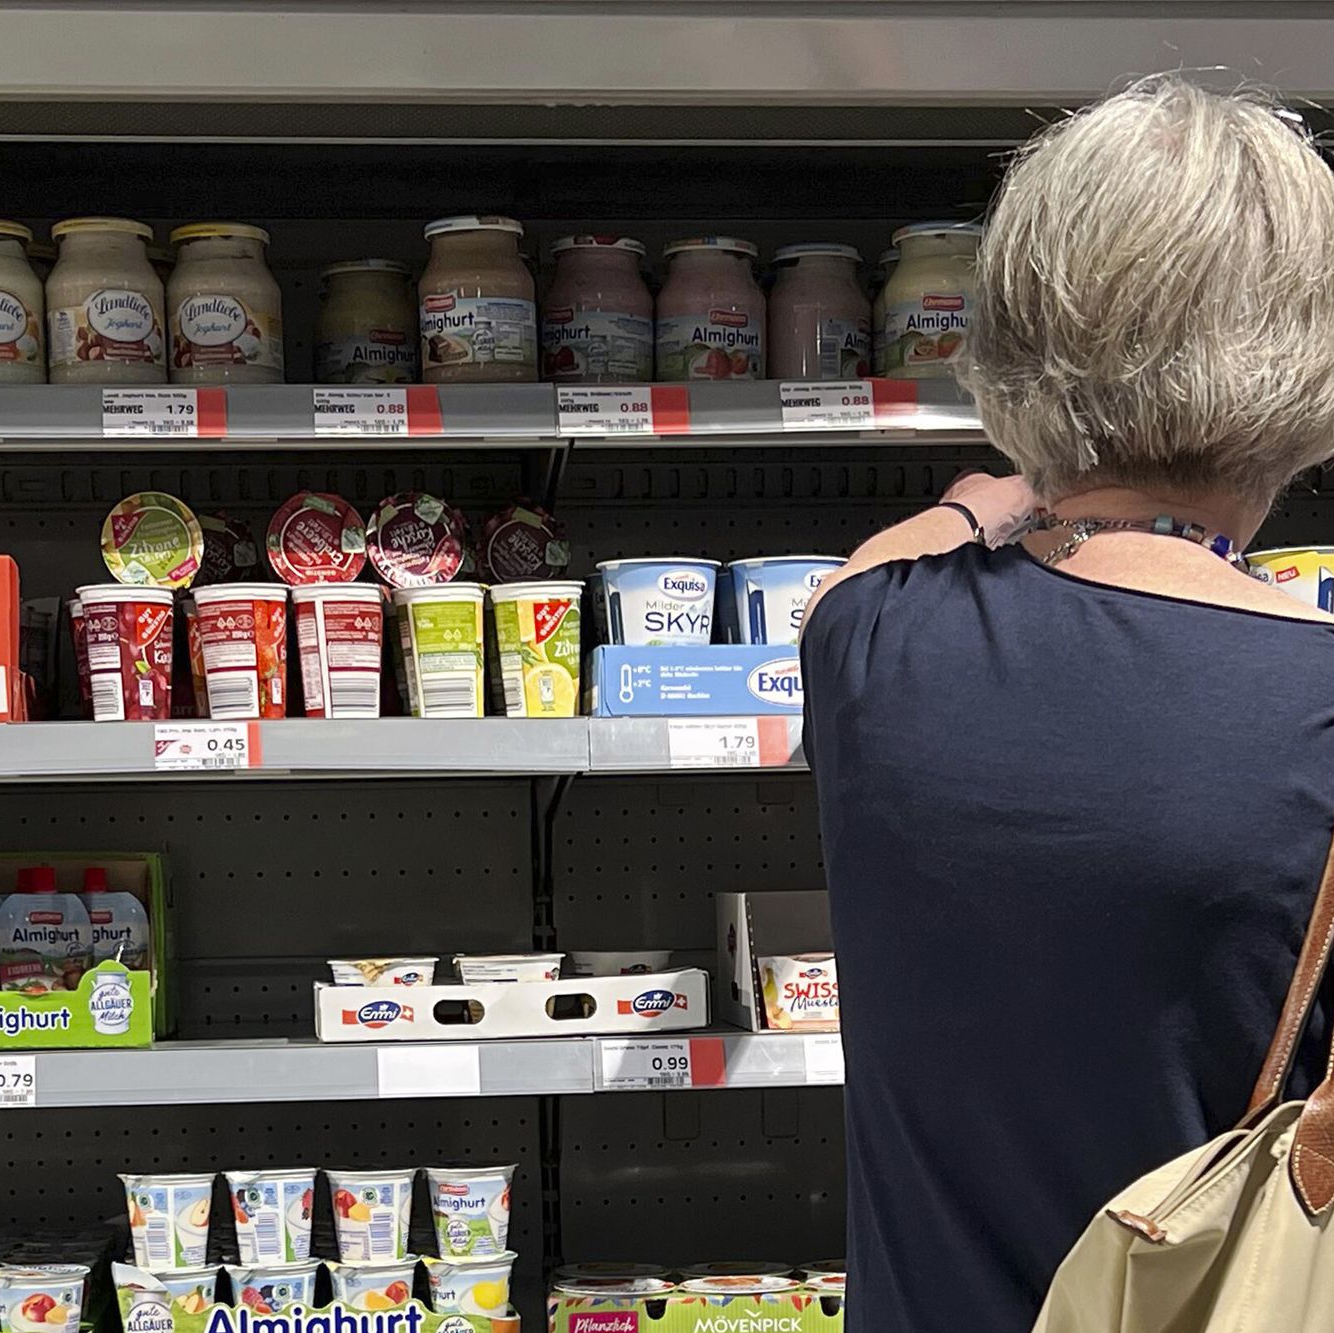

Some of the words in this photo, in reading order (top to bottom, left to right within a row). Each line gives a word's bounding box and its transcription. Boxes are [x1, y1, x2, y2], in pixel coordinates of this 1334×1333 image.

[94, 294, 151, 319] Landliebe
[692, 326, 760, 347] Almighurt
[376, 403, 405, 414] 0.88
[663, 577, 706, 593] Exquisa
[645, 611, 710, 635] SKYR
[207, 738, 245, 752] 0.45
[719, 736, 755, 749] 1.79
[359, 1003, 398, 1022] Emmi
[651, 1056, 688, 1071] 0.99
